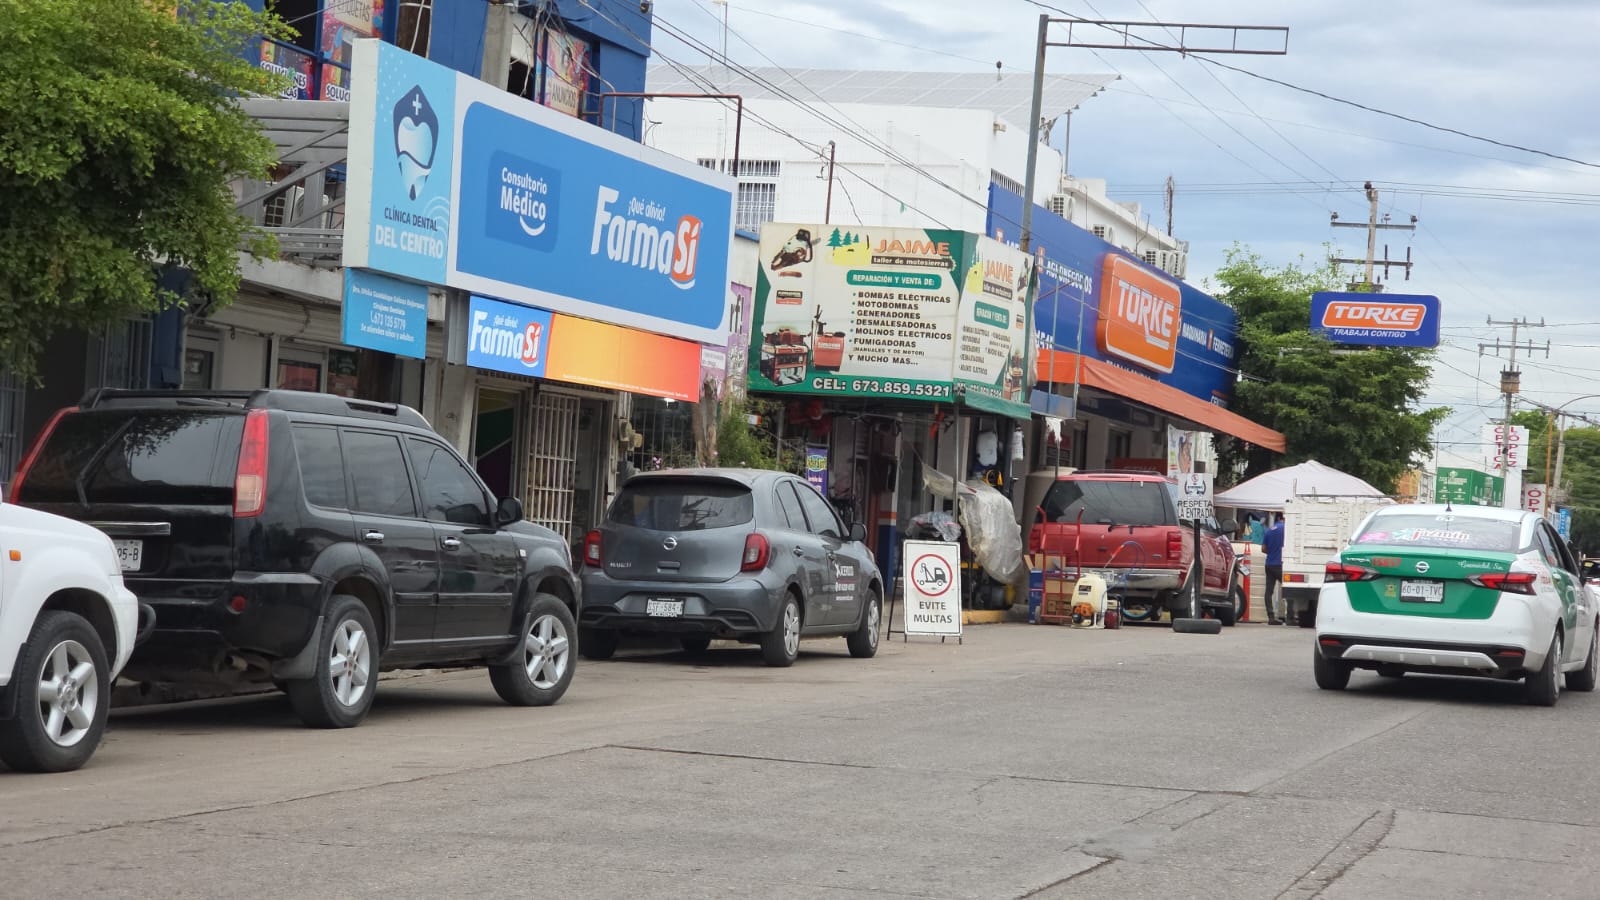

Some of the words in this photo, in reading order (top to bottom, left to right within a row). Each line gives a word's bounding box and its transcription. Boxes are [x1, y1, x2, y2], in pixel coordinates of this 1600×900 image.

[501, 166, 548, 195] Consultorio
[500, 186, 546, 220] Médico
[383, 205, 411, 225] CLÍNICA
[412, 216, 438, 232] DENTAL
[375, 224, 398, 249] DEL
[400, 230, 444, 259] CENTRO
[873, 239, 950, 255] JAIME
[873, 256, 893, 265] taller
[906, 258, 949, 268] motosierras
[984, 259, 1013, 284] JAIME
[894, 276, 900, 284] Y
[901, 276, 922, 285] VENTA
[858, 291, 894, 300] BOMBAS
[857, 301, 919, 311] MOTOBOMBAS
[857, 310, 921, 319] GENERADORES
[1116, 280, 1174, 349] TORKE
[1333, 305, 1420, 325] TORKE
[856, 319, 937, 329] DESMALESADORAS
[855, 328, 895, 337] MOLINOS
[1334, 329, 1369, 337] TRABAJA
[1370, 330, 1407, 338] CONTIGO
[853, 338, 917, 348] FUMIGADORAS
[857, 355, 889, 363] MUCHO
[812, 378, 847, 391] CEL:
[852, 380, 950, 398] 673.859.5321
[1177, 500, 1213, 508] RESPETA
[1177, 508, 1185, 519] LA
[1186, 508, 1213, 518] ENTRADA
[919, 601, 946, 610] EVITE
[914, 614, 952, 624] MULTAS
